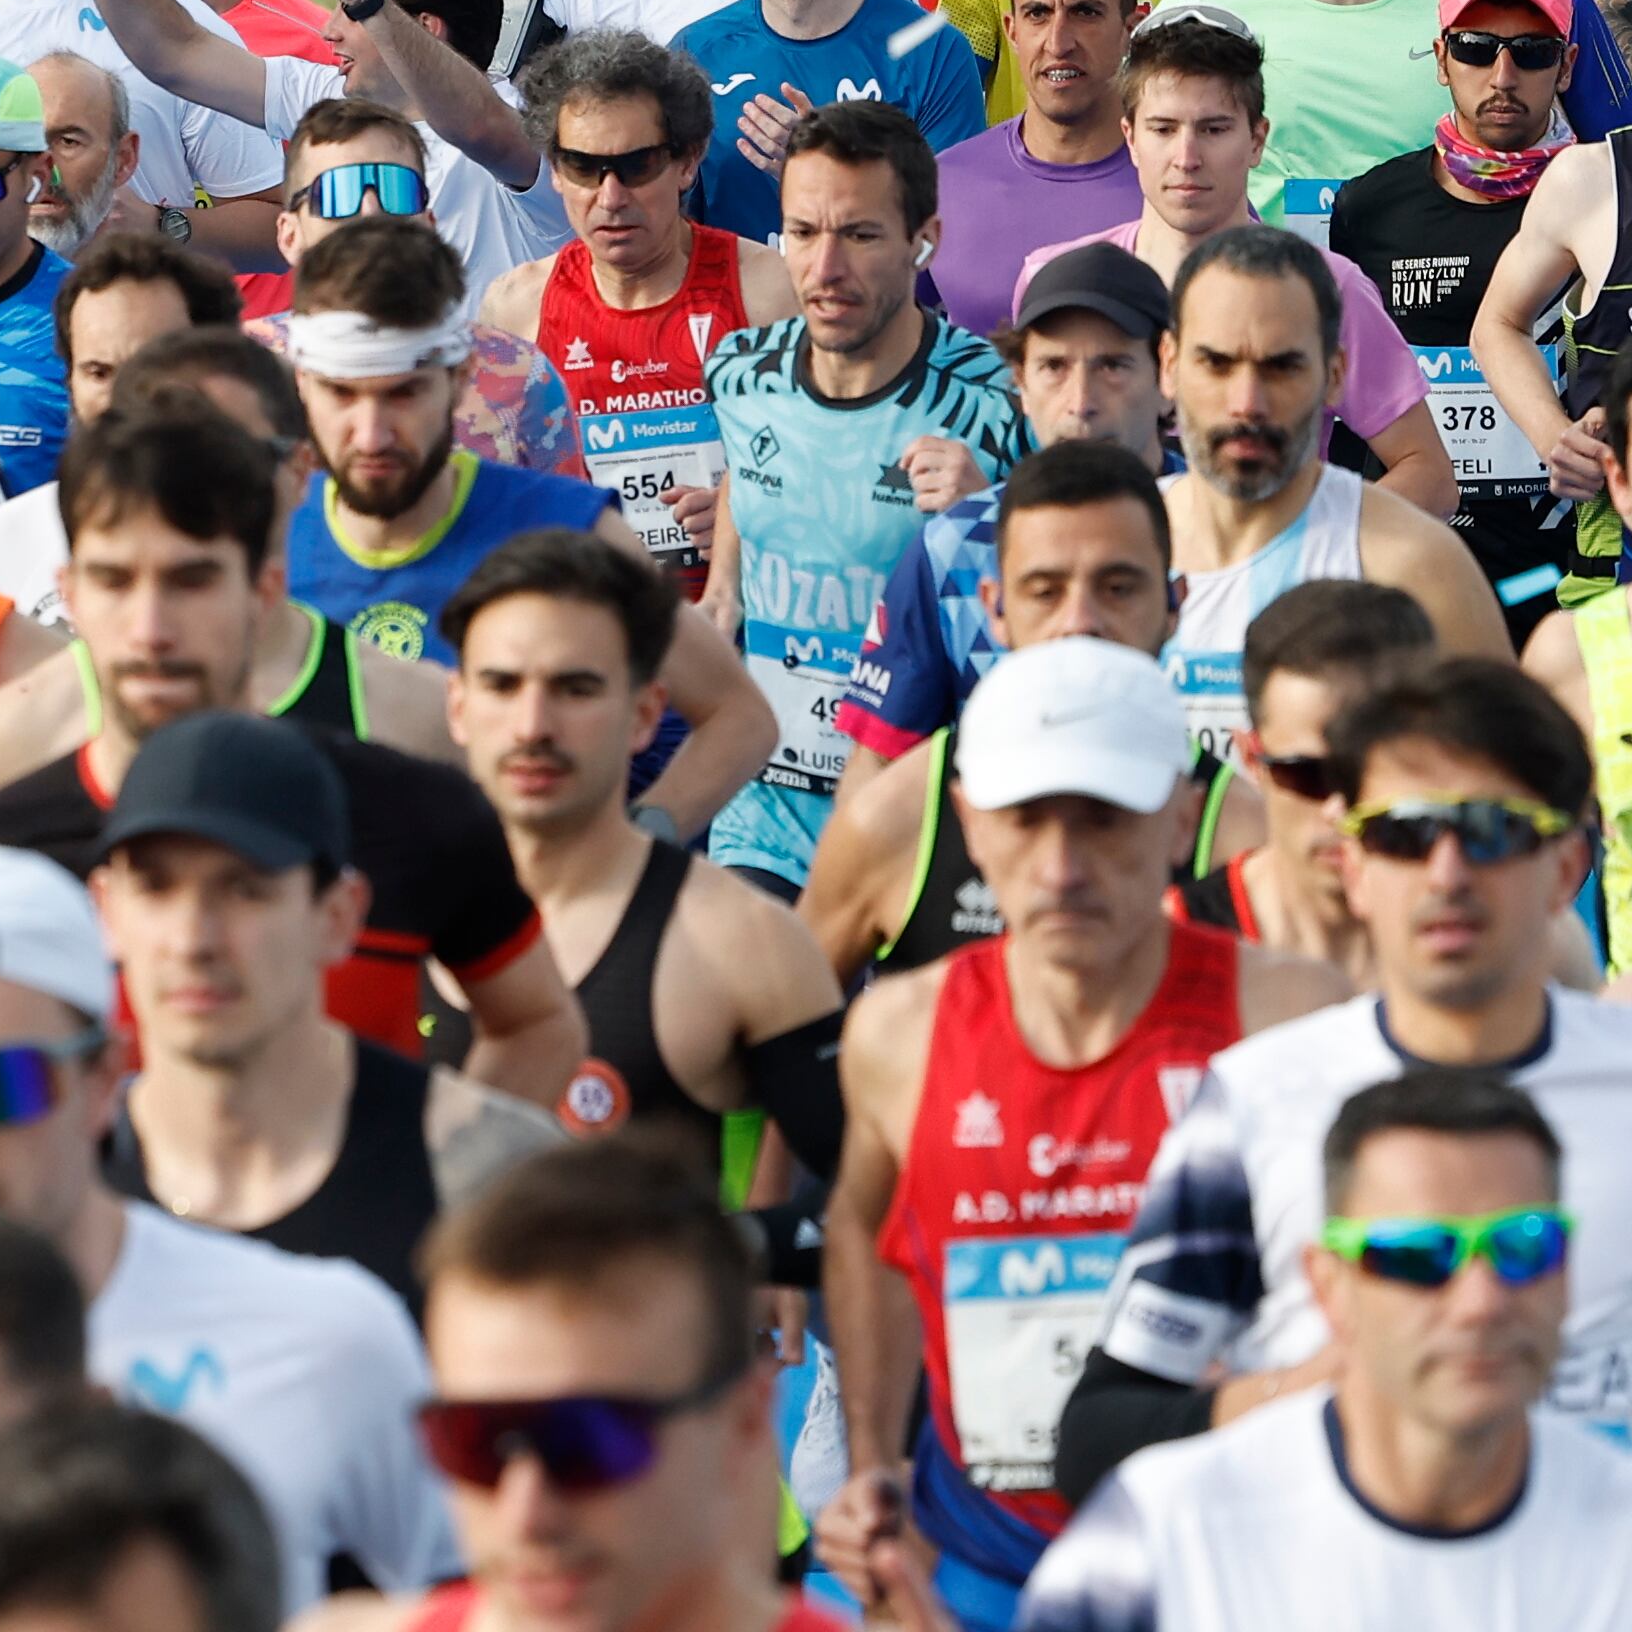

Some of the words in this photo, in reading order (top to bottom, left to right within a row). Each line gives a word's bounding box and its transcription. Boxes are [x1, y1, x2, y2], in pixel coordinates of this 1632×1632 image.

[1405, 257, 1431, 270] SERIES
[1432, 256, 1470, 268] RUNNING
[1391, 281, 1431, 307] RUN
[625, 359, 669, 378] alquiber
[607, 388, 708, 414] MARATHO
[631, 418, 698, 438] Movistar
[1442, 405, 1497, 431] 378
[1452, 458, 1492, 475] FELI
[622, 470, 678, 502] 554
[800, 749, 845, 774] LUIS
